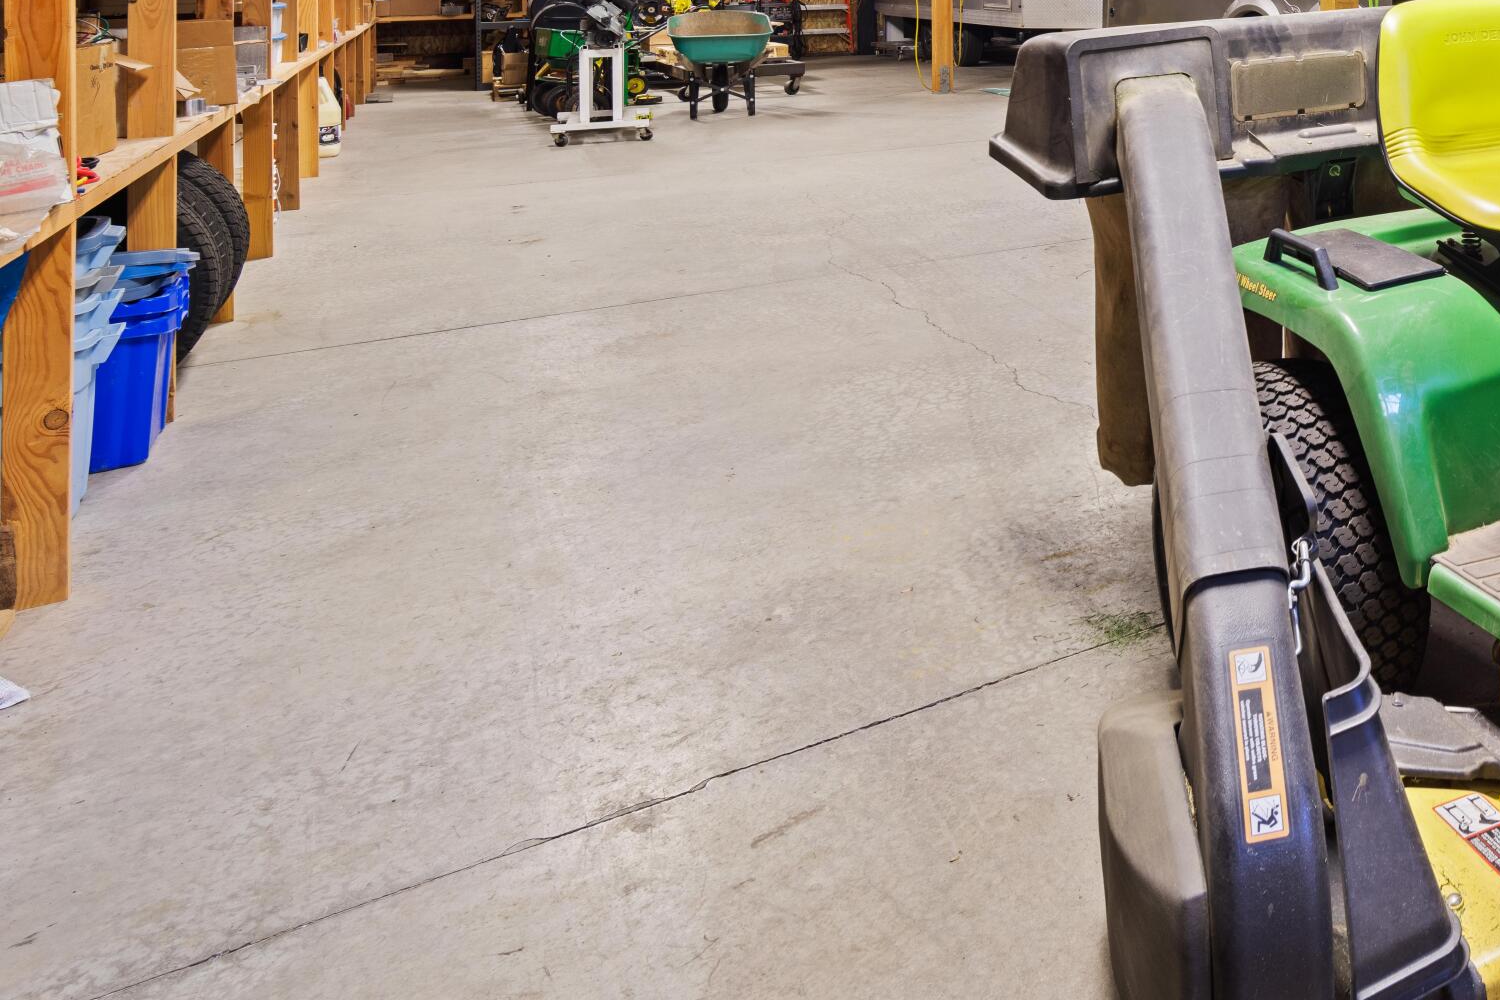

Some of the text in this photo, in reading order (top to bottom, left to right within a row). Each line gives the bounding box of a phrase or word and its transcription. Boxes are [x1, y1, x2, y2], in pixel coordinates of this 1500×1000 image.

[1240, 274, 1259, 293] Wheel
[1258, 283, 1277, 301] Steer
[1266, 717, 1278, 762] WARNING
